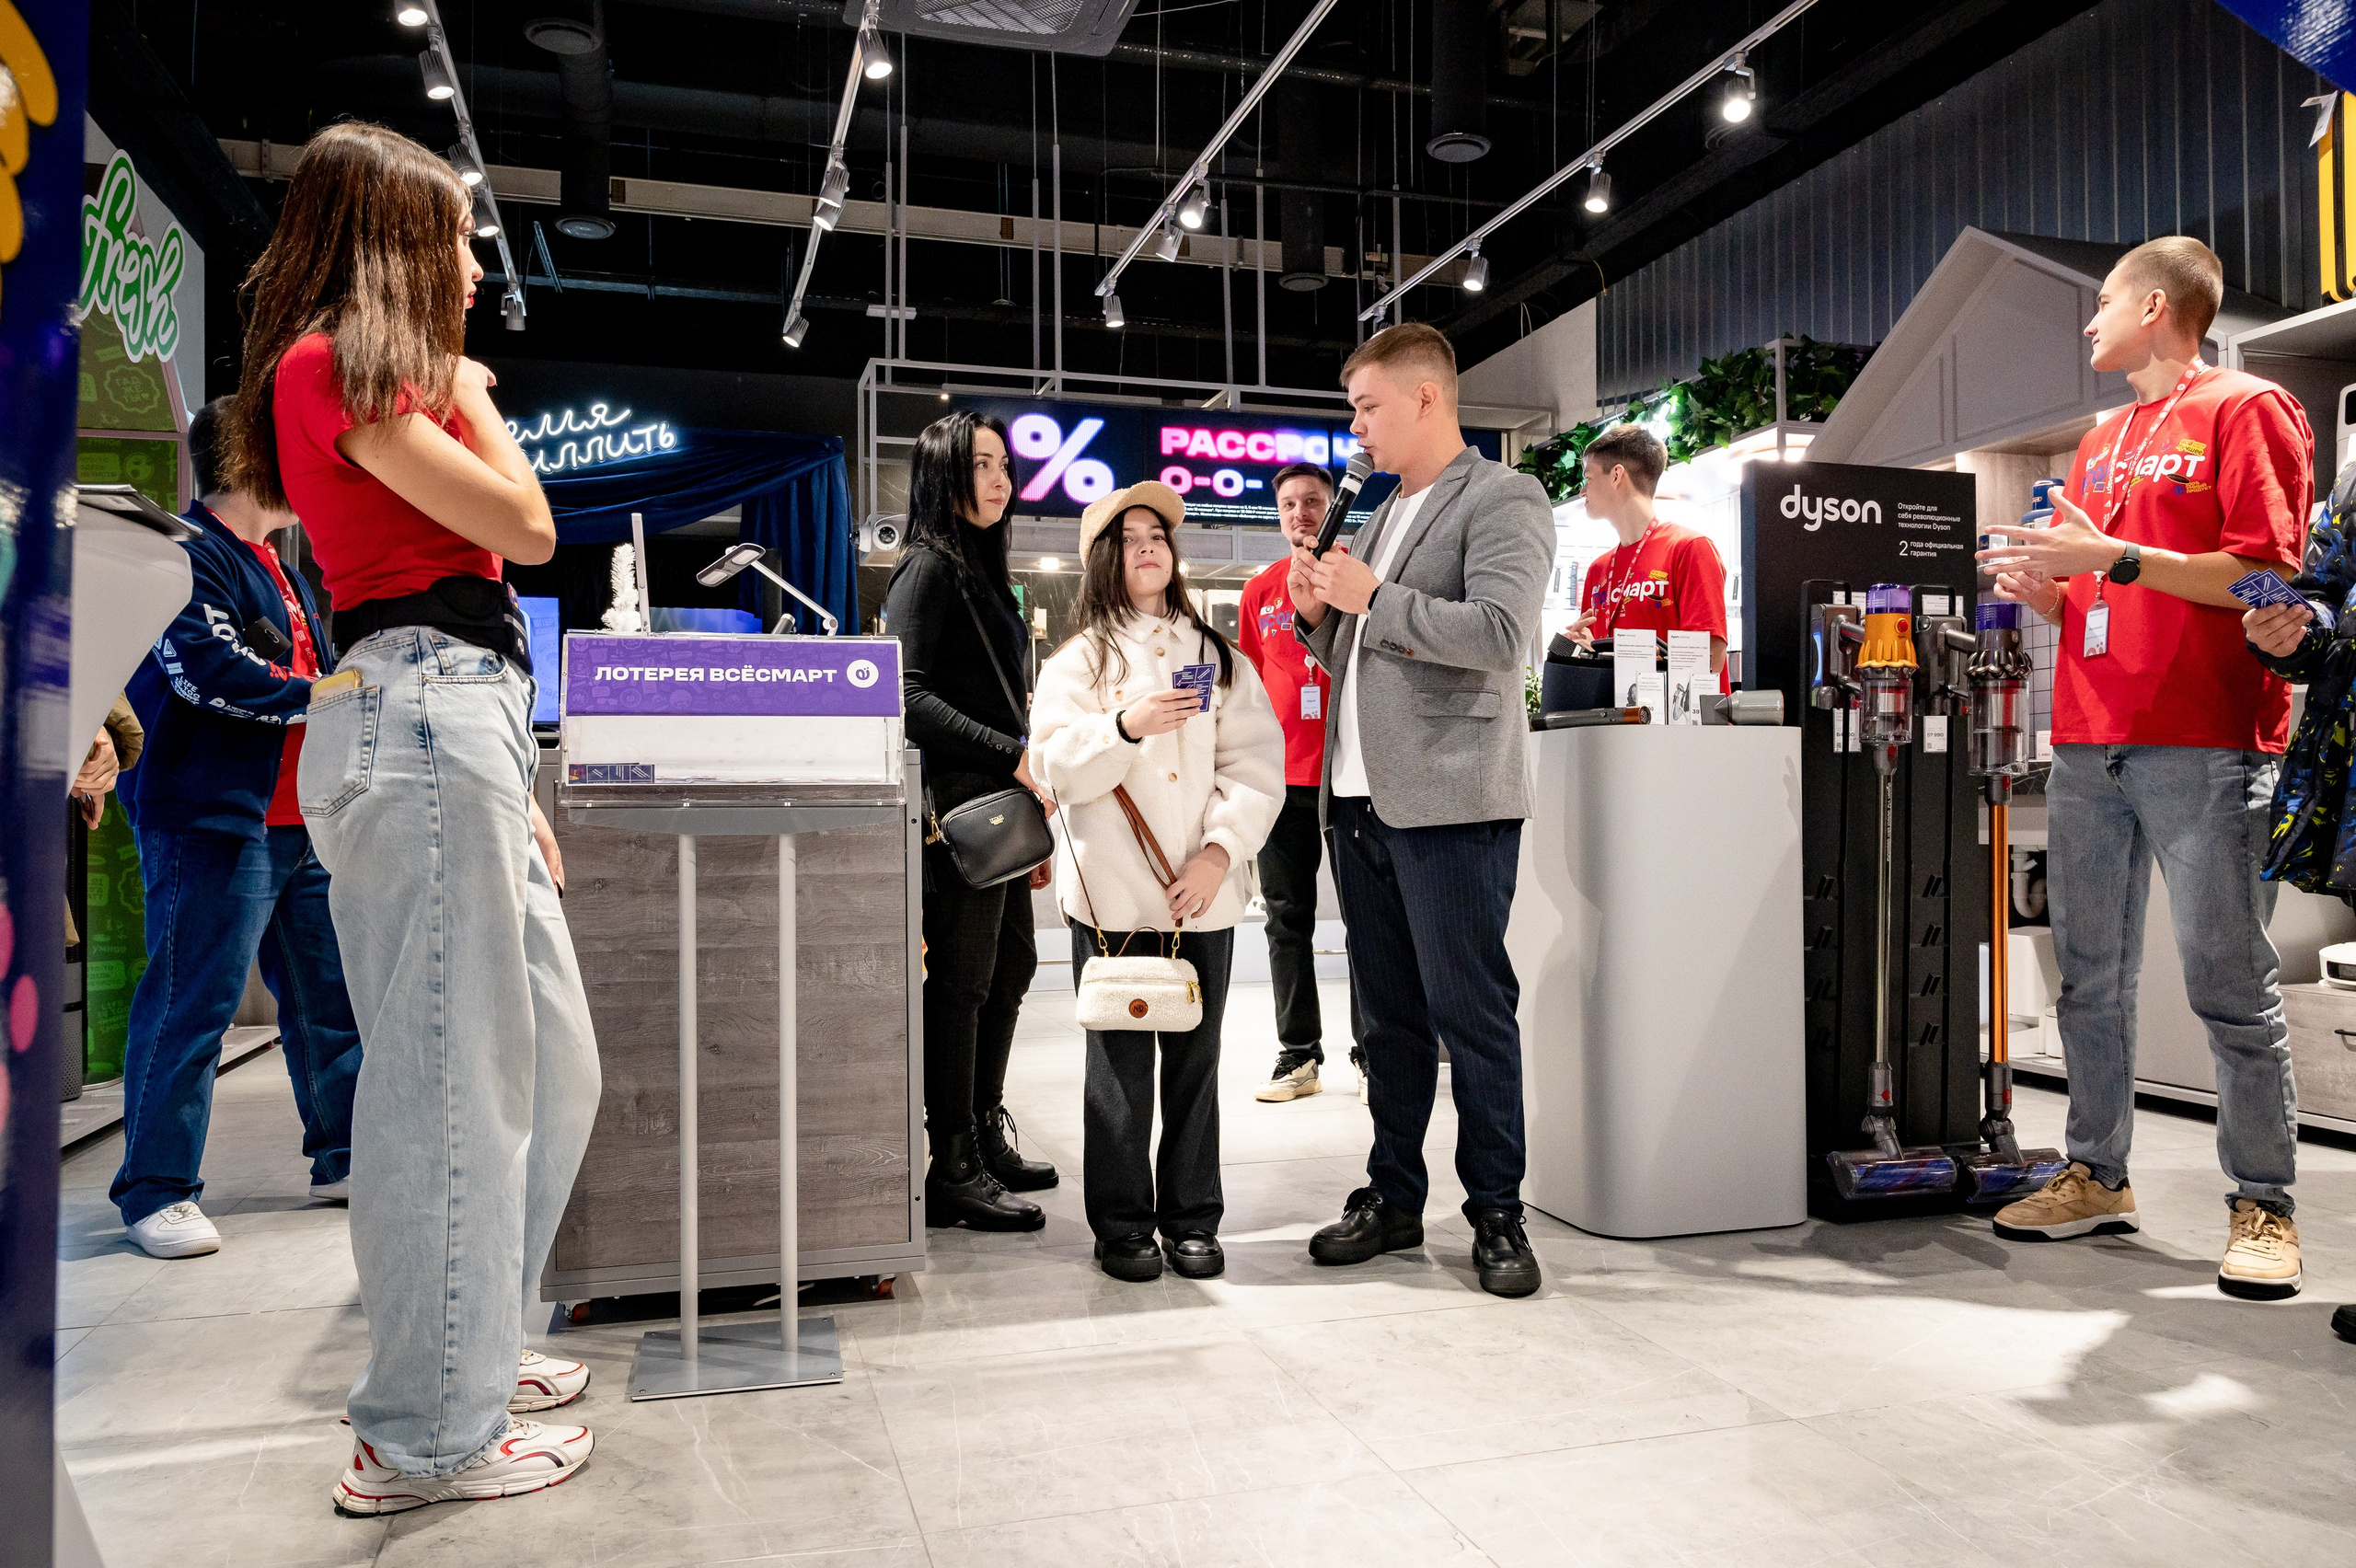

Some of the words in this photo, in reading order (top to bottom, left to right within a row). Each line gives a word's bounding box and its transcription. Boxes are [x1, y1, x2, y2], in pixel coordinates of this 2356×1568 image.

[531, 422, 676, 472] иллить
[1161, 427, 1359, 465] РАССРОЧ
[1780, 484, 1882, 532] dyson
[1898, 502, 1925, 512] Откройте
[1912, 514, 1960, 523] революционные
[1933, 523, 1951, 531] Dyson
[1899, 540, 1909, 556] 2
[1924, 541, 1964, 549] официальная
[595, 666, 704, 682] ЛОТЕРЕЯ
[710, 664, 837, 683] ВСЁСМАРТ
[179, 675, 199, 693] LIFE
[183, 685, 201, 698] TOO
